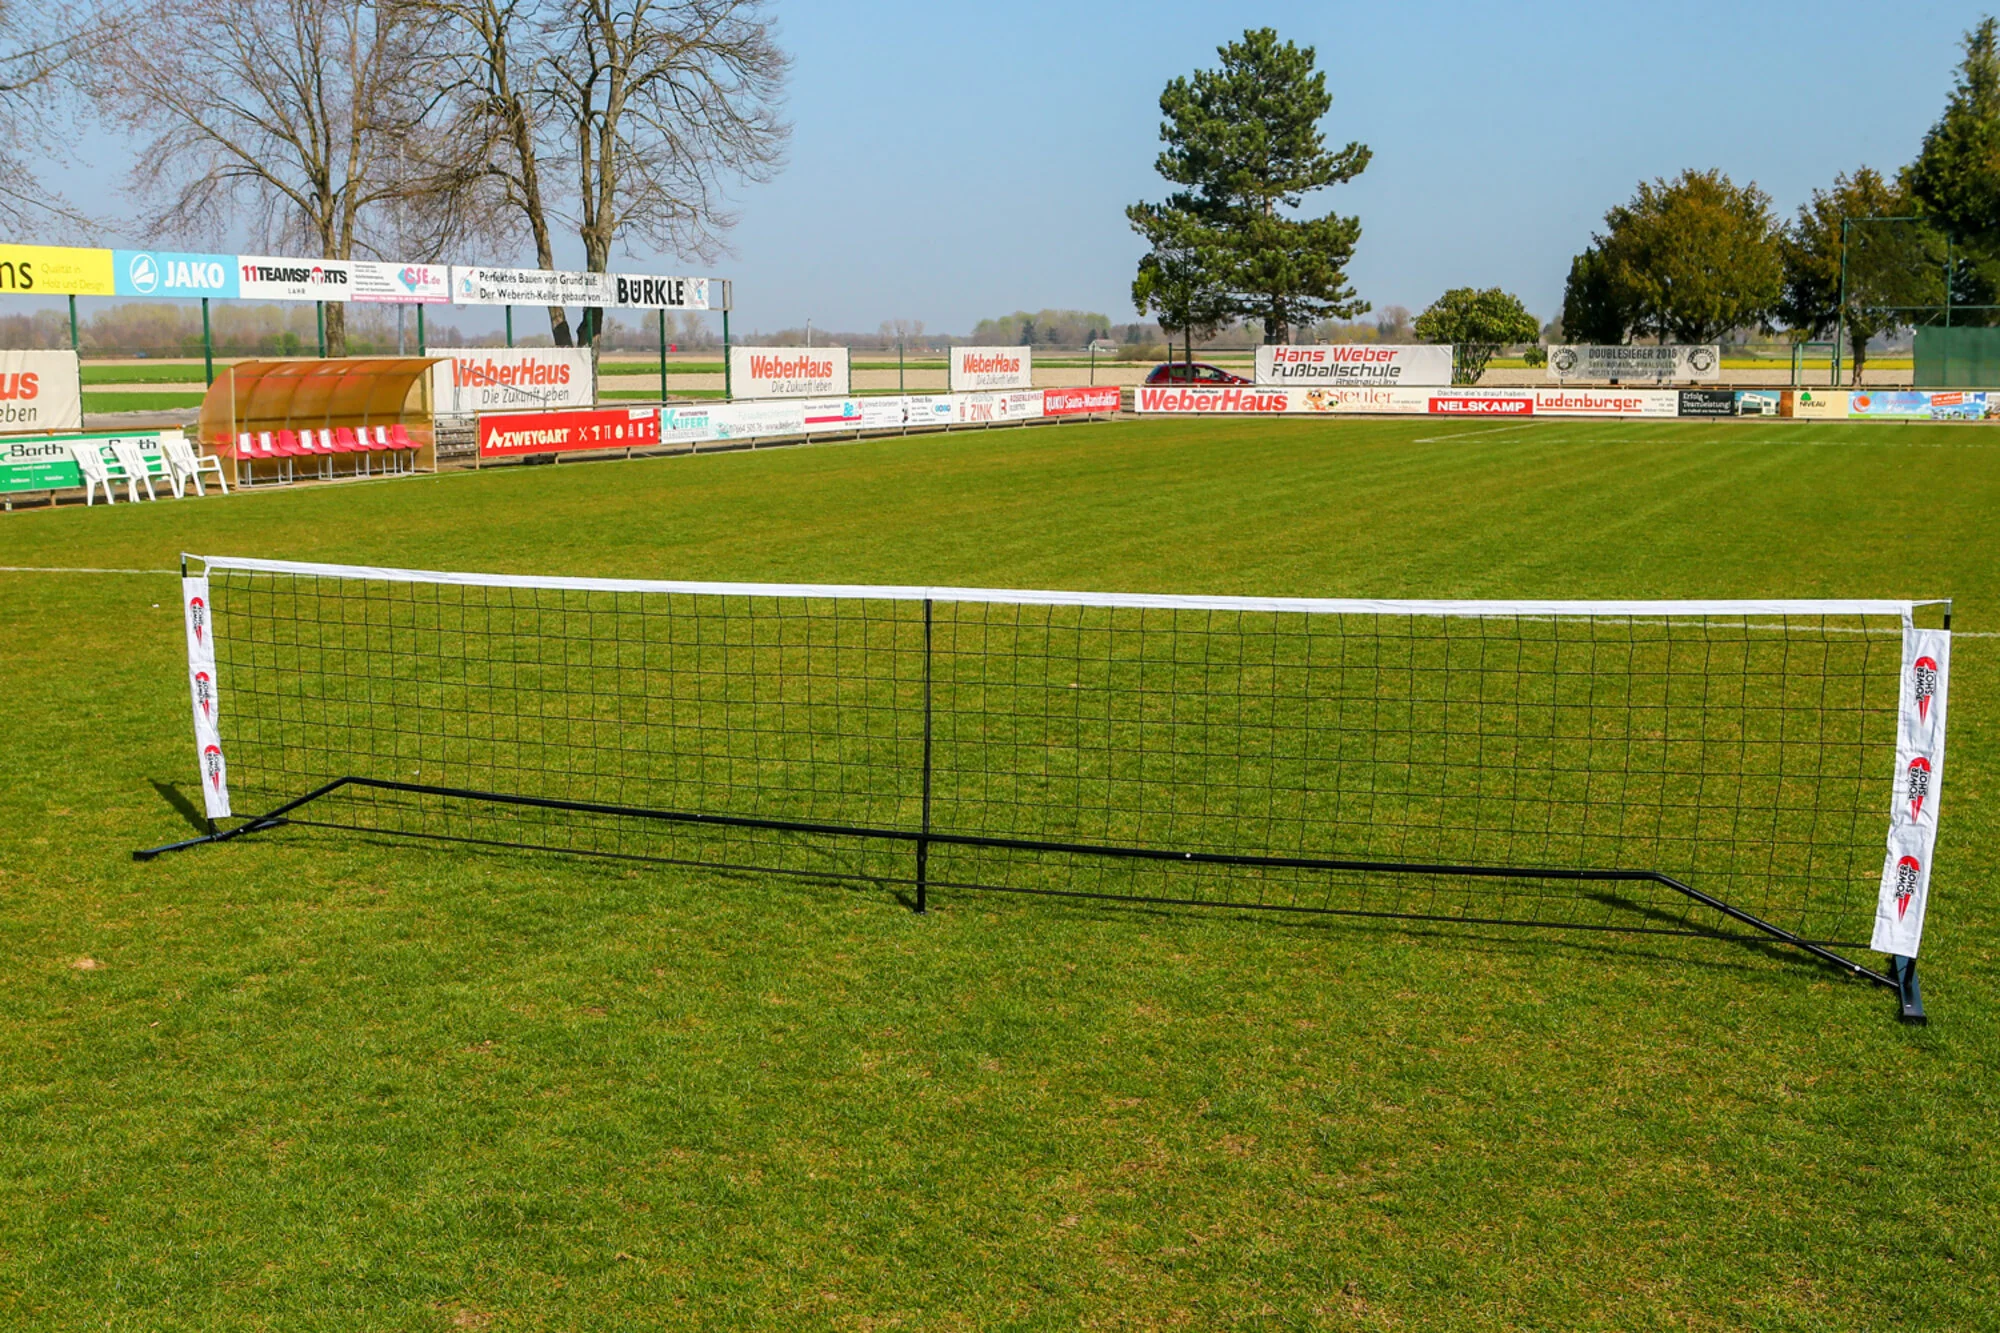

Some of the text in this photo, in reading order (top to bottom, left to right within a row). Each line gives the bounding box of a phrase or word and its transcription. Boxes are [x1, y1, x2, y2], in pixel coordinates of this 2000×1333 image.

[63, 279, 77, 289] und
[164, 261, 225, 289] JAKO
[479, 271, 517, 284] Perfektes
[519, 273, 542, 284] Bauen
[544, 276, 558, 285] von
[559, 275, 583, 286] Grund
[480, 288, 495, 299] Der
[618, 278, 685, 306] BÜRKLE
[963, 353, 1020, 373] WeberHaus
[1274, 347, 1398, 362] Hans Weber
[1588, 349, 1653, 359] DOUBLESIEGER
[451, 358, 570, 387] WeberHaus
[750, 355, 833, 379] WeberHaus
[1271, 363, 1401, 378] Fußballschule
[482, 389, 500, 404] Die
[502, 387, 540, 403] Zukunft
[771, 380, 833, 393] Die Zukunft leben
[1141, 390, 1288, 411] WeberHaus
[1437, 401, 1525, 412] NELSKAMP
[1537, 393, 1642, 411] Ladenburger
[1682, 400, 1731, 409] Teamleistung!
[1683, 393, 1704, 402] Erfolg
[971, 403, 993, 421] ZINK
[11, 444, 64, 457] Barth
[1916, 667, 1924, 701] POWER
[1925, 670, 1934, 696] SHOT
[1909, 767, 1919, 800] POWER
[1918, 770, 1928, 796] SHOT
[1896, 865, 1908, 898] POWER
[1905, 868, 1917, 894] SHOT
